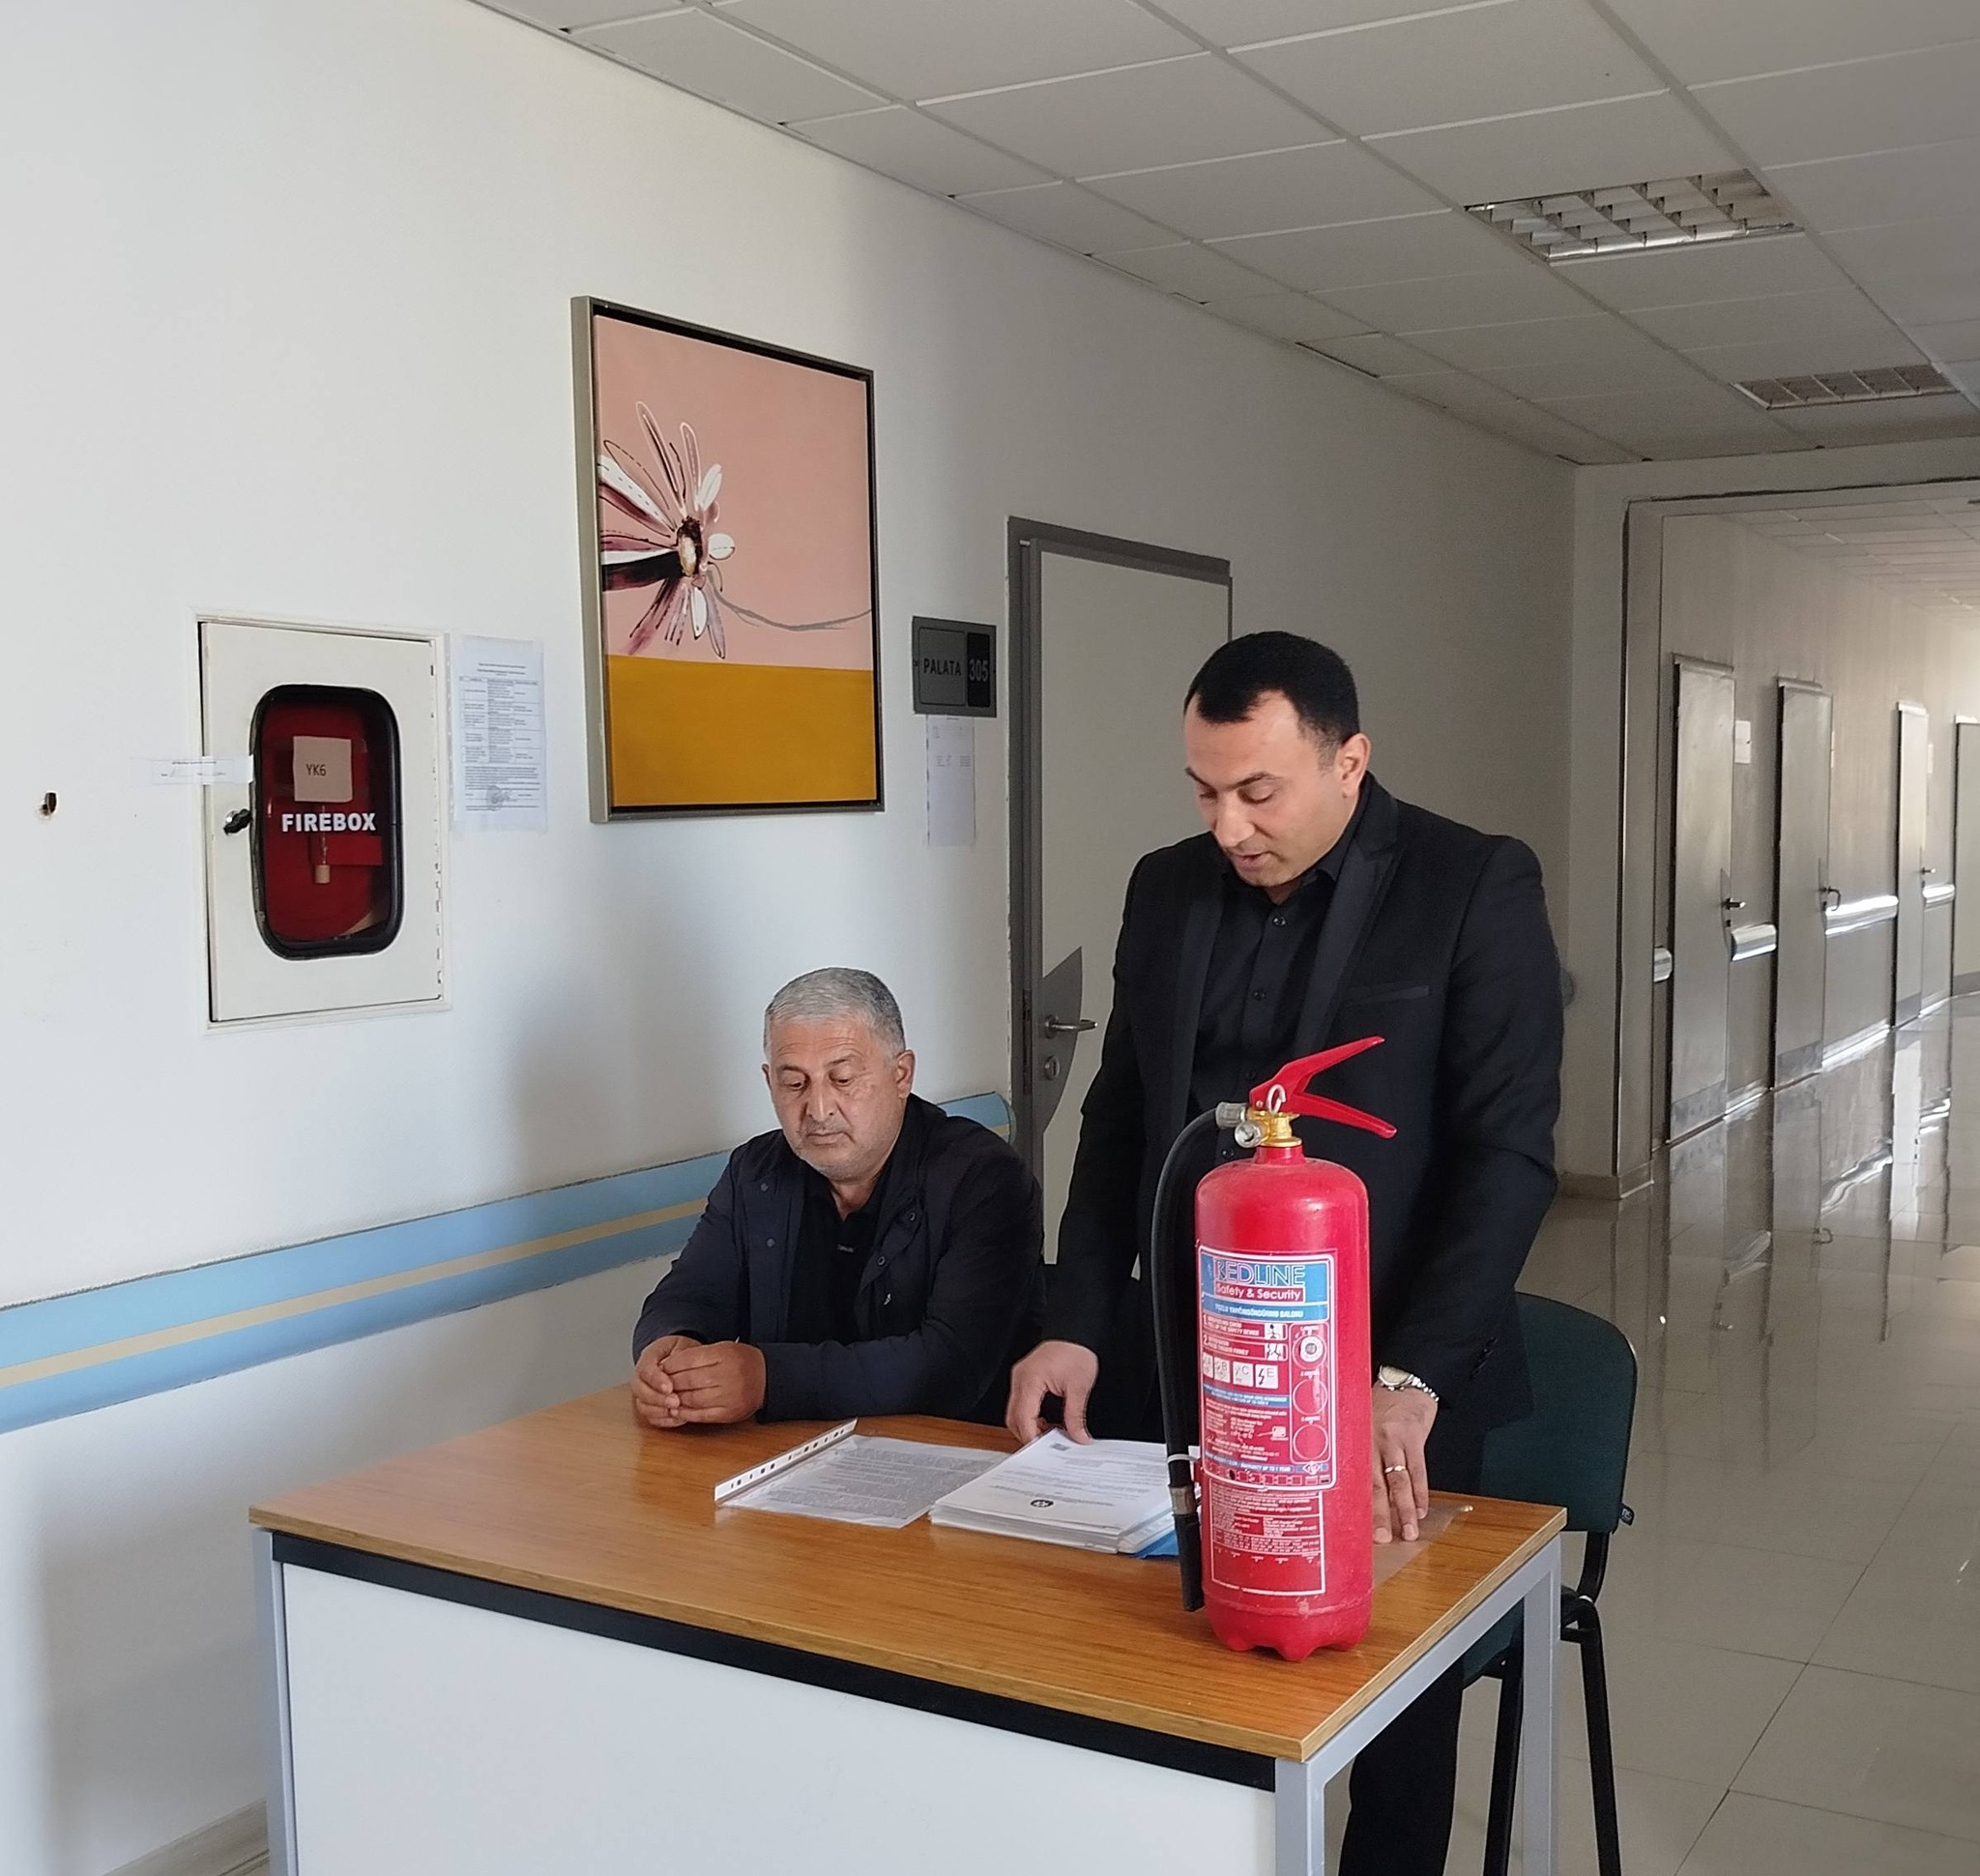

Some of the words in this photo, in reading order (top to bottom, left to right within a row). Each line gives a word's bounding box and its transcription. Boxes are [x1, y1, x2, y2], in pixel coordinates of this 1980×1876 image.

[923, 658, 962, 676] PALATA
[969, 658, 989, 683] 305
[306, 763, 327, 777] YK6
[281, 812, 377, 833] FIREBOX
[1216, 1283, 1244, 1299] Safety
[1246, 1288, 1255, 1299] &
[1257, 1288, 1301, 1301] Security
[1221, 1362, 1228, 1371] B
[1241, 1365, 1249, 1375] C
[1267, 1367, 1274, 1378] E
